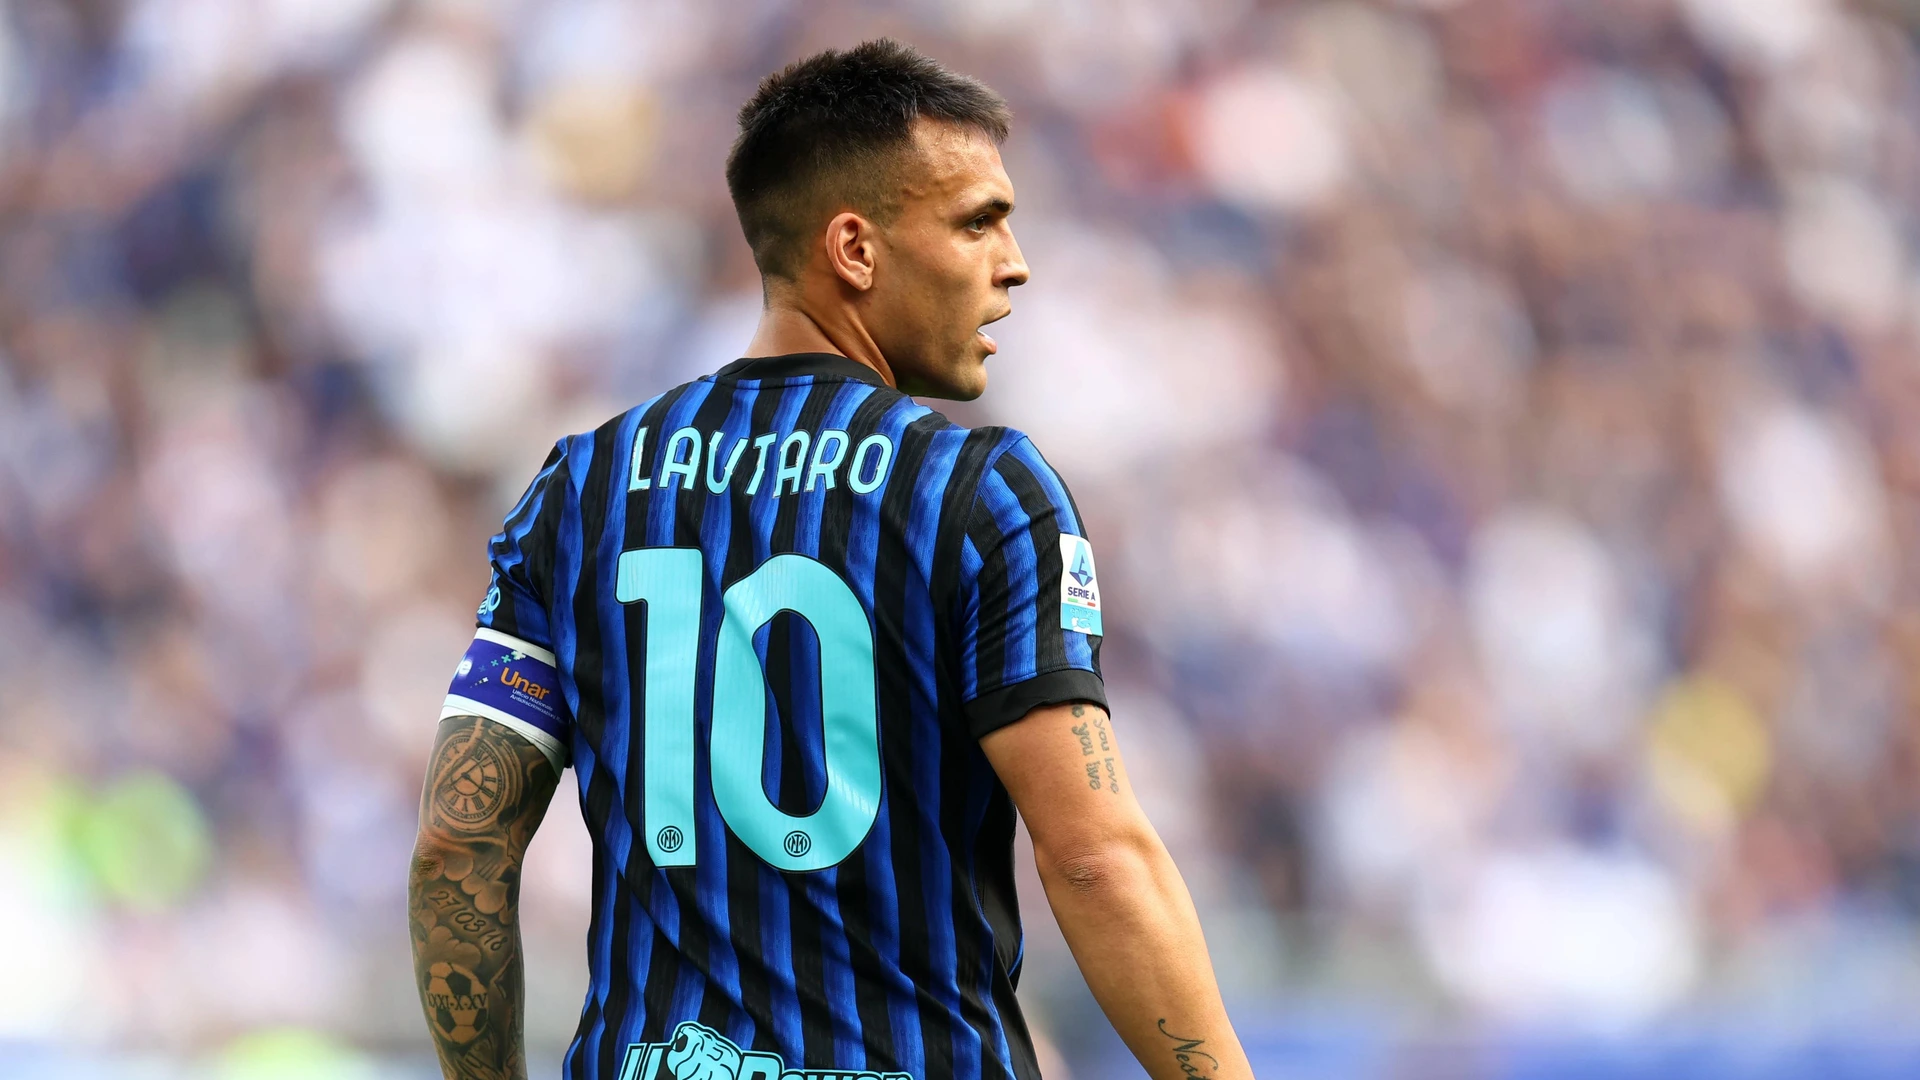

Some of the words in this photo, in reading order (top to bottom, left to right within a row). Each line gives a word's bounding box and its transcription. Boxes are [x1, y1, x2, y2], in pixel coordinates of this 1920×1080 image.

[627, 426, 894, 498] LAUTARO
[1067, 586, 1090, 600] SERIE
[1090, 592, 1096, 601] A
[500, 666, 550, 700] Unar
[616, 547, 881, 872] 10
[1071, 722, 1095, 756] you
[1093, 718, 1110, 751] you
[1104, 756, 1119, 794] love
[428, 890, 509, 951] 27/03/18
